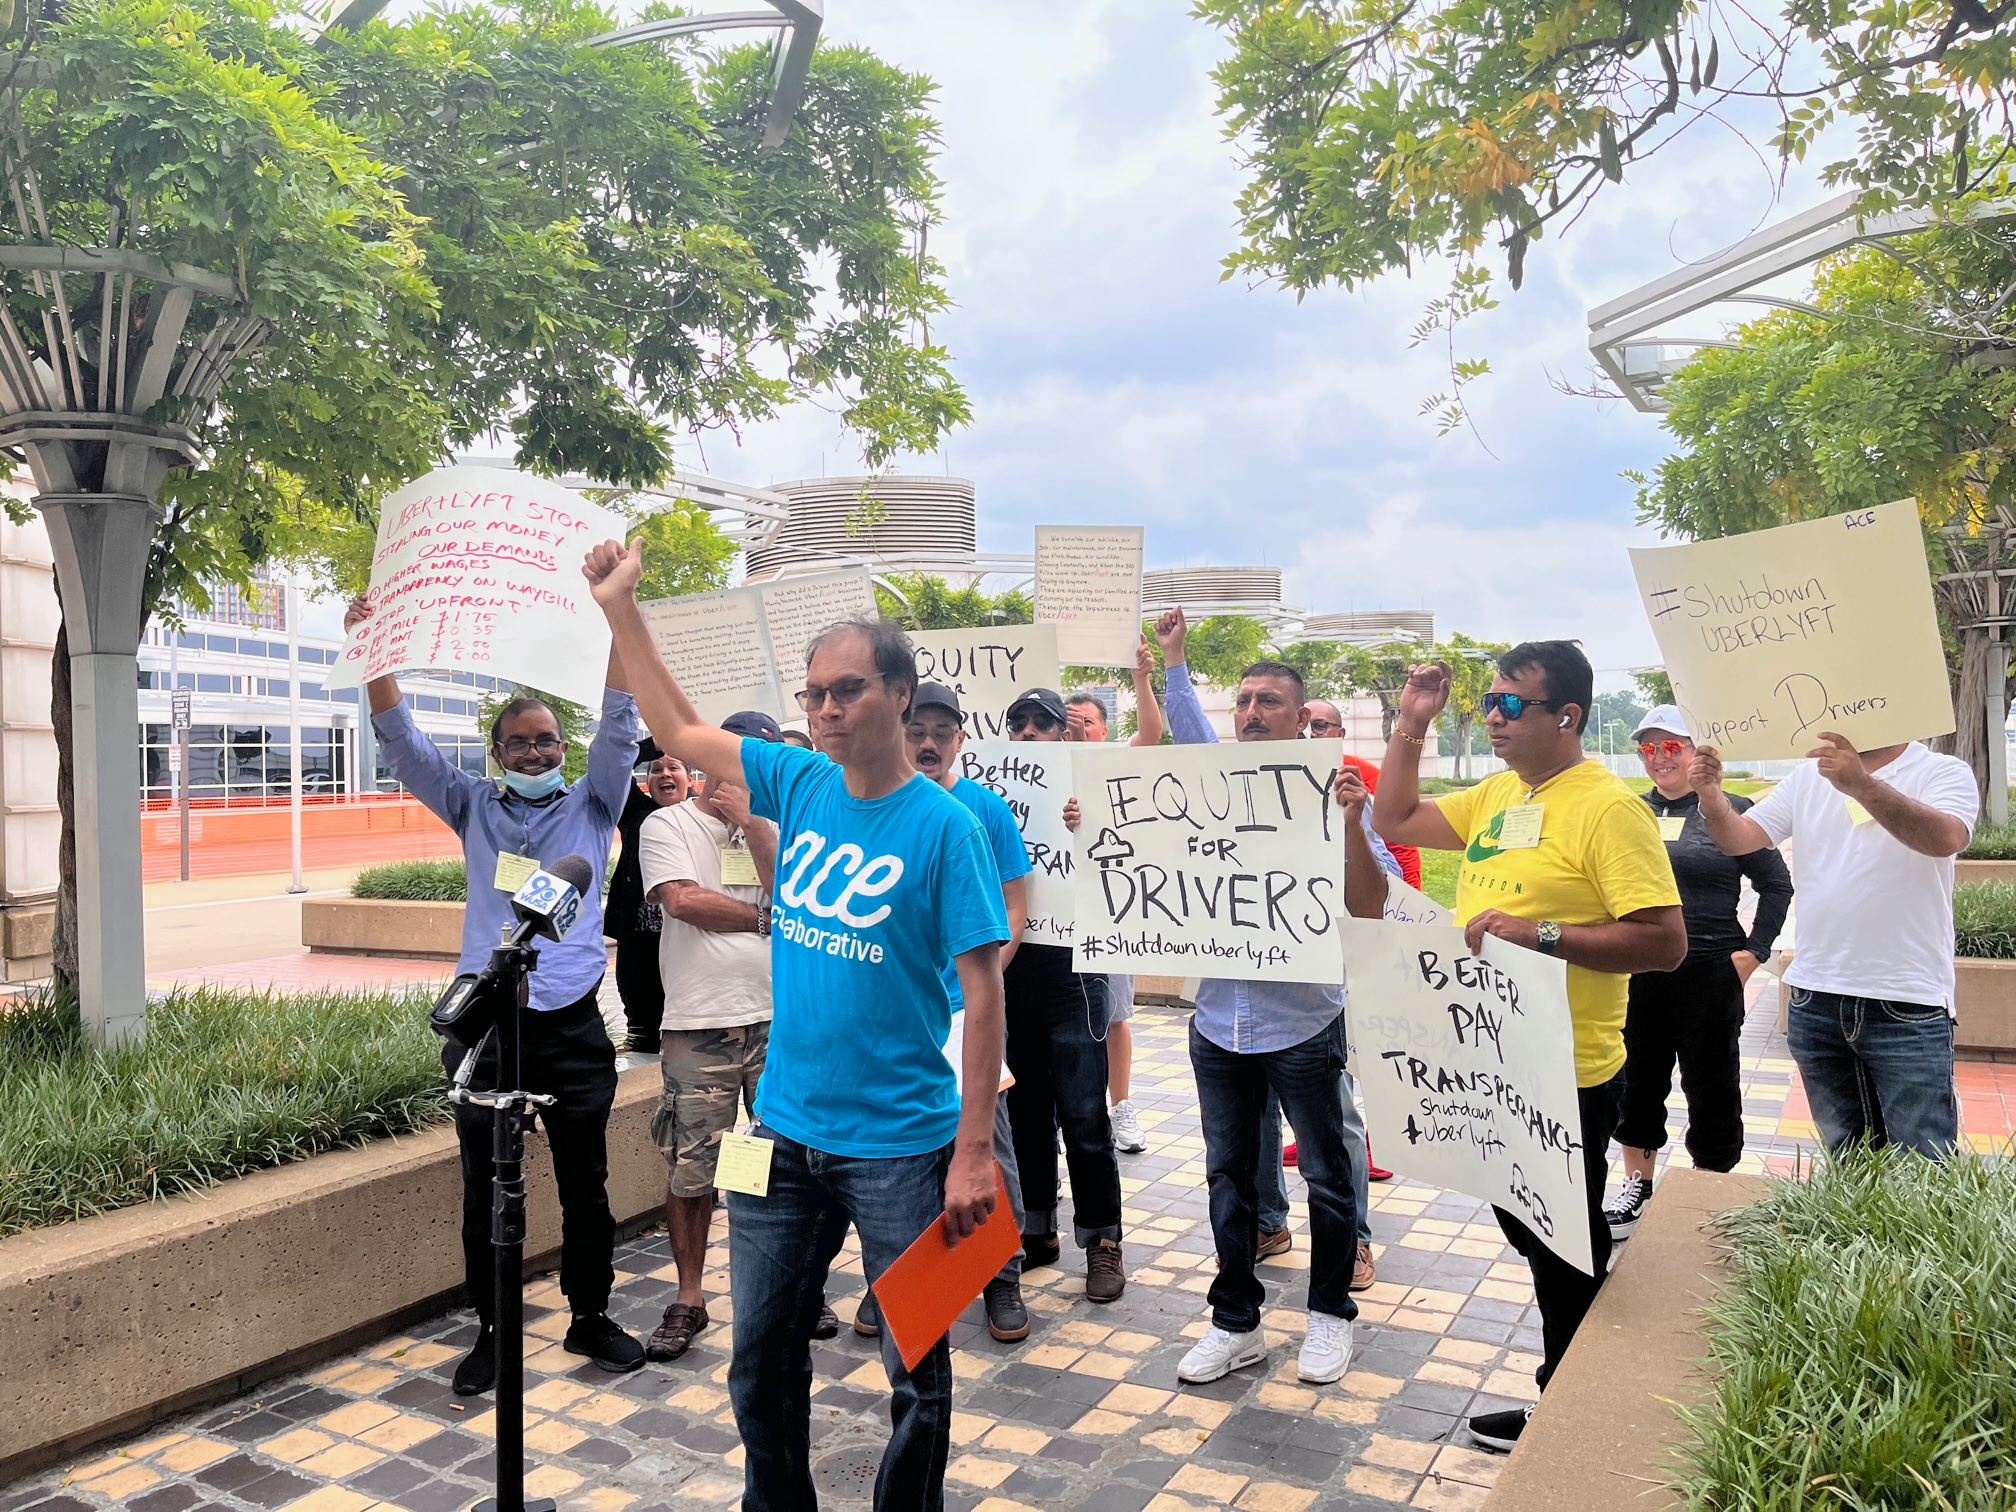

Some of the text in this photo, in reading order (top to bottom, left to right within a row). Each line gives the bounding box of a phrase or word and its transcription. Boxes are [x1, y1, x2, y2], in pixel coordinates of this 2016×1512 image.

[526, 502, 589, 533] STOP
[1843, 511, 1876, 530] ACE
[375, 520, 564, 566] STEALING OUR MONEY
[418, 541, 555, 567] OUR DEMANDS
[384, 563, 422, 591] HIGHER
[430, 559, 490, 571] WAGES
[473, 577, 496, 587] ON
[506, 581, 577, 614] WAYBILL
[1650, 573, 1827, 625] #Shutdown
[374, 605, 405, 631] STOP
[390, 616, 420, 635] MILE
[1700, 603, 1836, 654] UBERLYFT
[390, 630, 414, 645] MNT
[914, 645, 1024, 682] QUITY
[1674, 673, 1887, 747] Support Drivers
[1106, 764, 1339, 842] EQUITY
[1187, 836, 1243, 868] FOR
[520, 892, 548, 911] WUSA
[1099, 864, 1334, 944] DRIVERS
[1417, 950, 1525, 1017] BETTER
[1447, 1002, 1504, 1064] PAY
[1420, 1097, 1495, 1124] Shutdown
